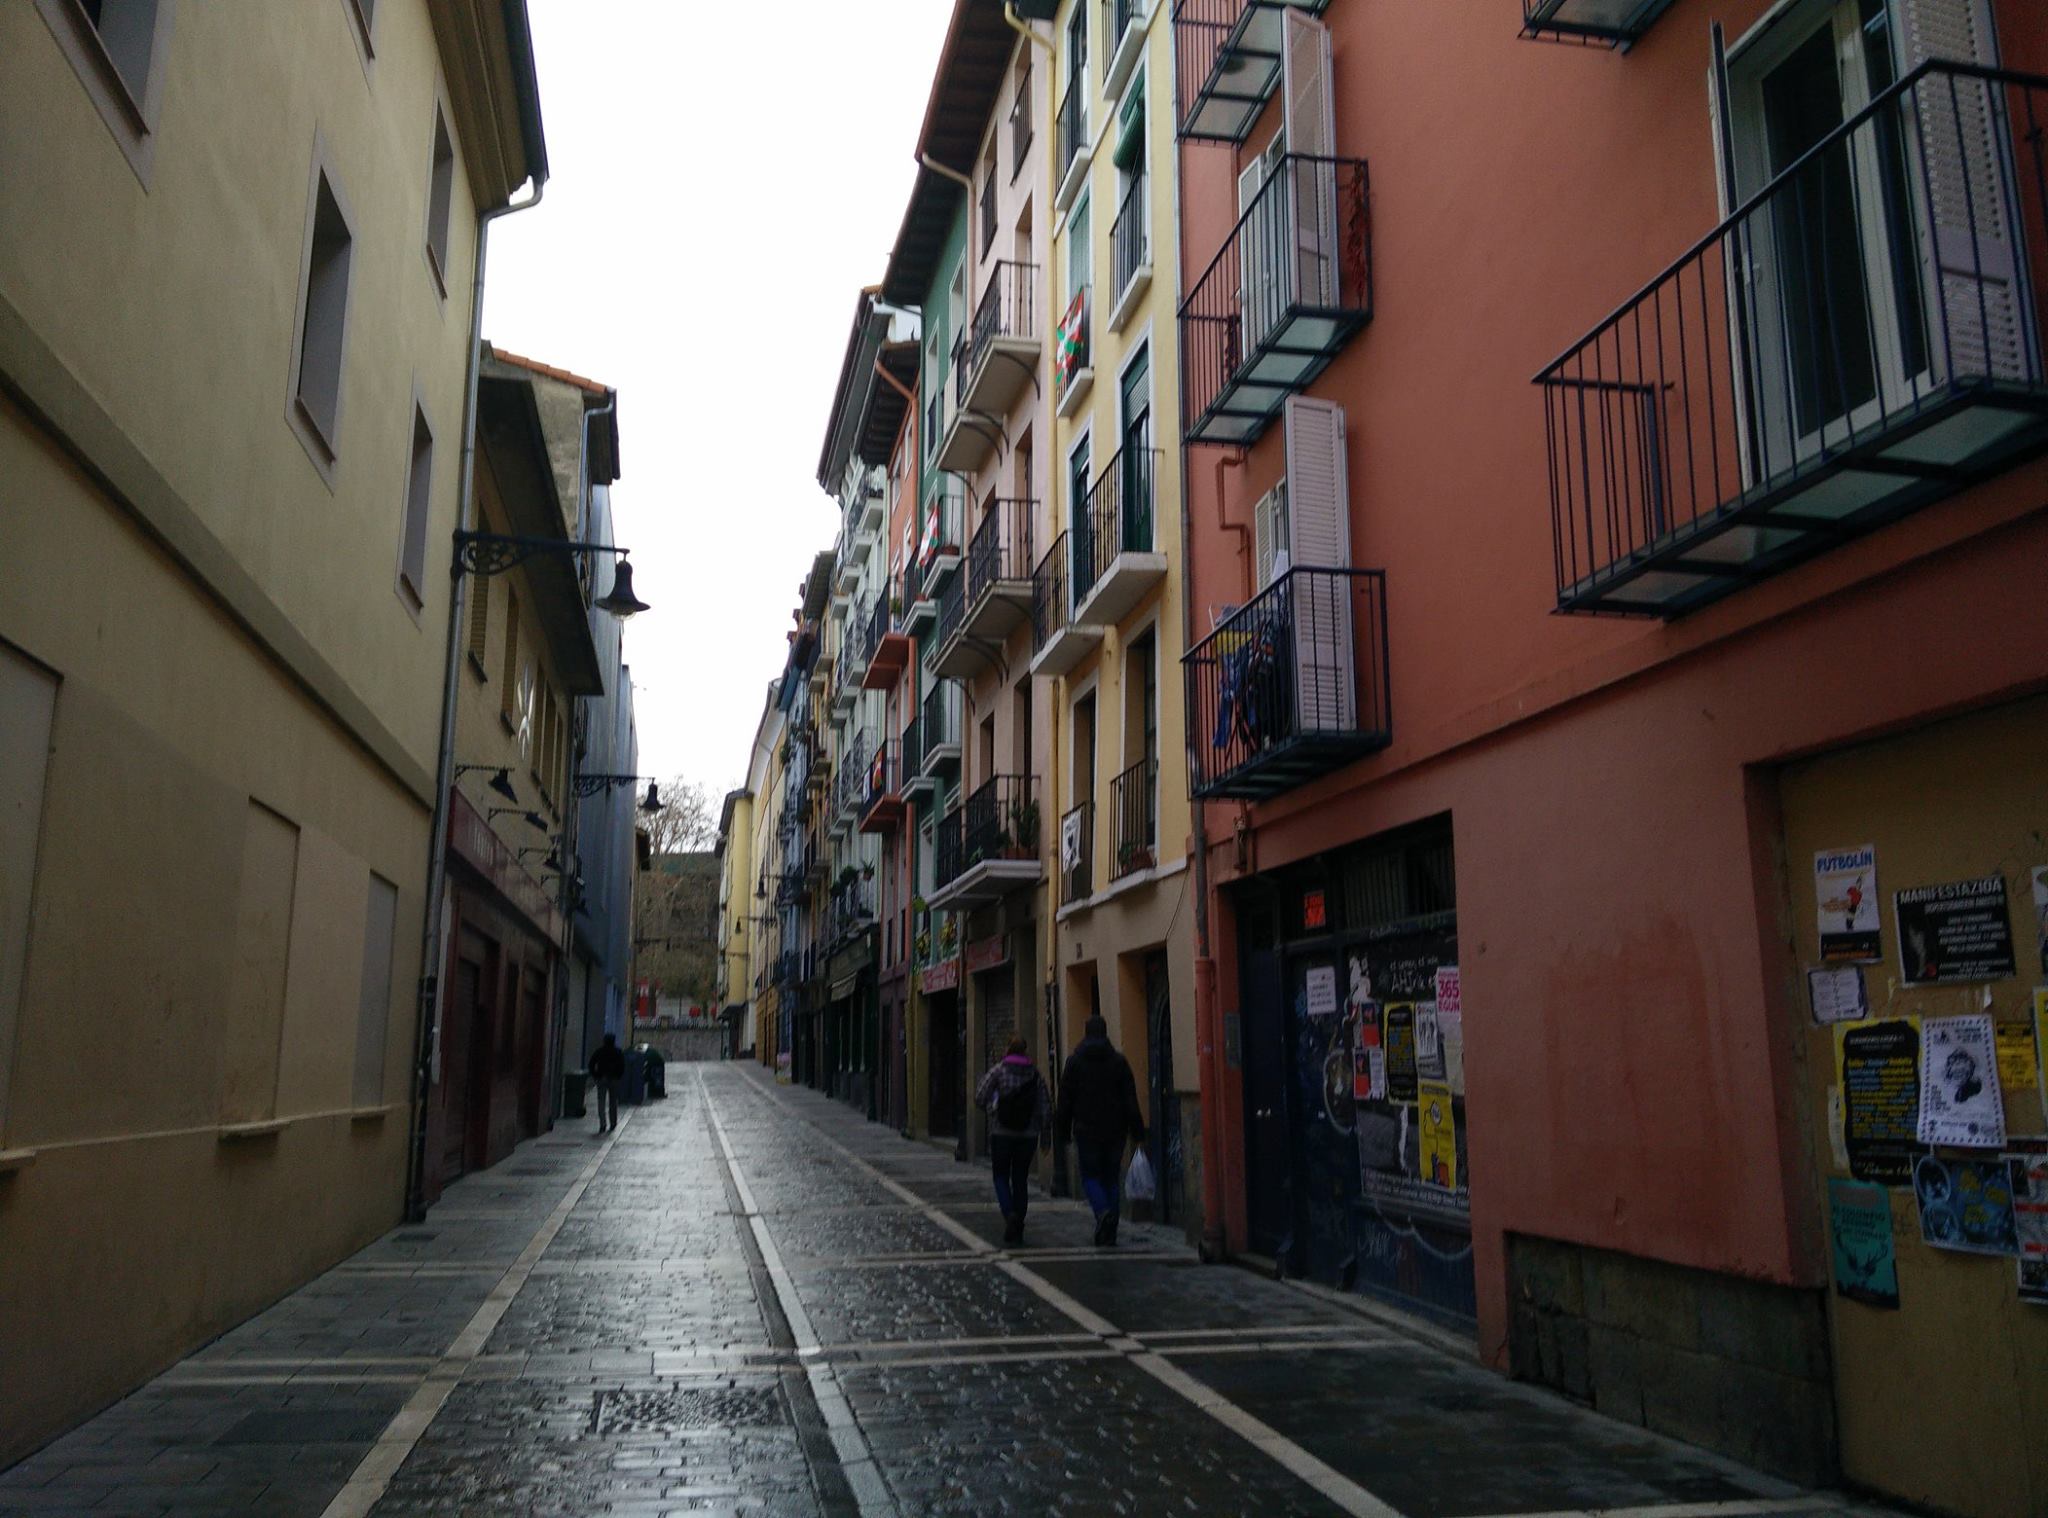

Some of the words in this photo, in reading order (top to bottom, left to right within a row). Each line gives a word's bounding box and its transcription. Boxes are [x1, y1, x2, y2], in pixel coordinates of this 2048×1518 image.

[1816, 851, 1873, 874] FUTBOLÍN
[1900, 877, 2003, 905] MANIFESTAZIOA
[1438, 979, 1460, 999] 365
